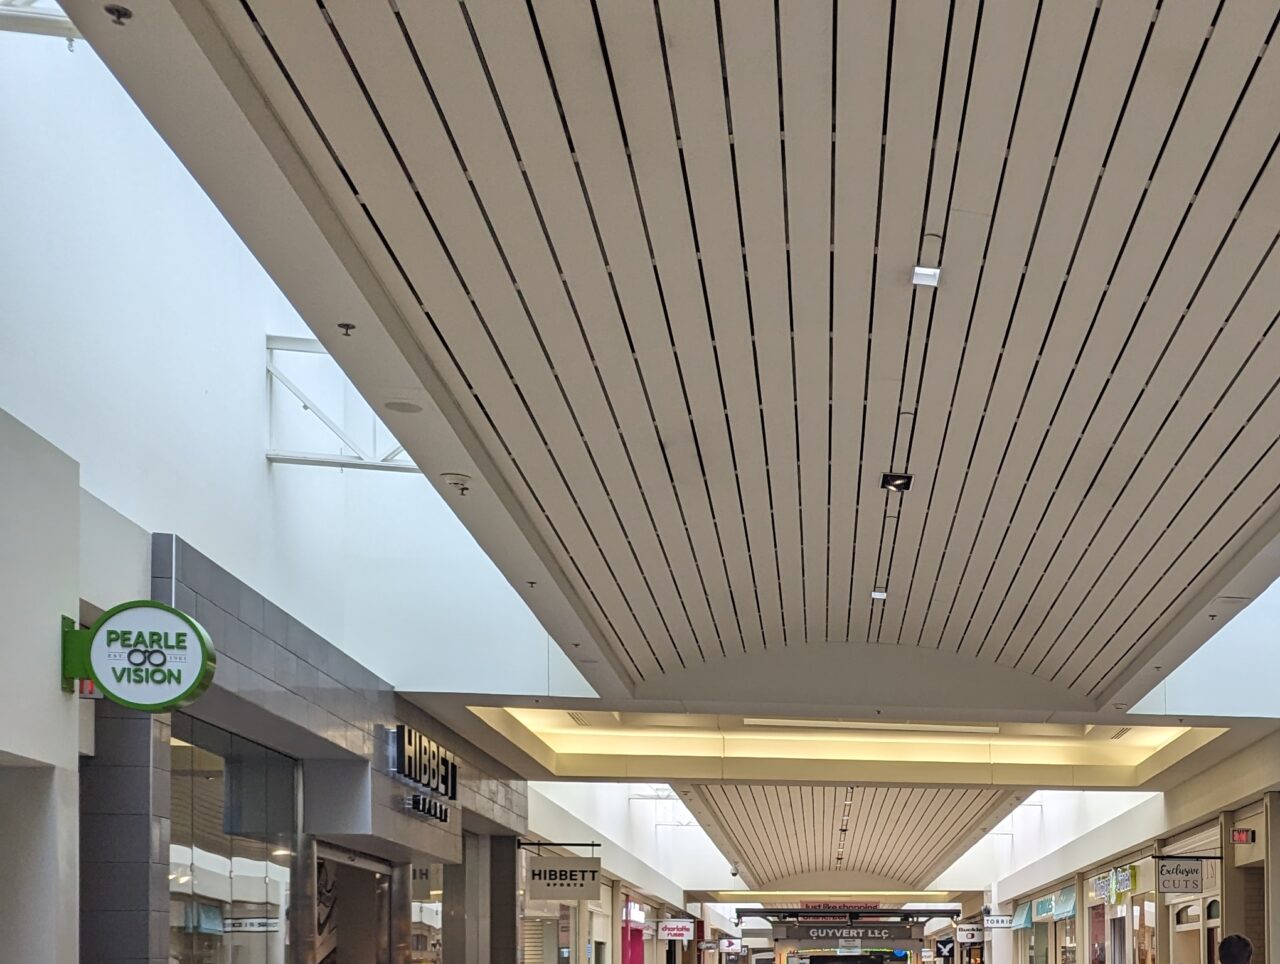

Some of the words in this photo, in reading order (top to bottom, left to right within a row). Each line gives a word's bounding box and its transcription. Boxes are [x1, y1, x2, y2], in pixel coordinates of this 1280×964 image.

[106, 630, 188, 650] PEARLE
[111, 667, 182, 685] VISION
[531, 869, 599, 881] HIBBETT
[1160, 863, 1200, 877] Exclusive
[1162, 879, 1199, 889] CUTS
[661, 924, 691, 933] charlotte
[809, 928, 865, 938] GUYVERT
